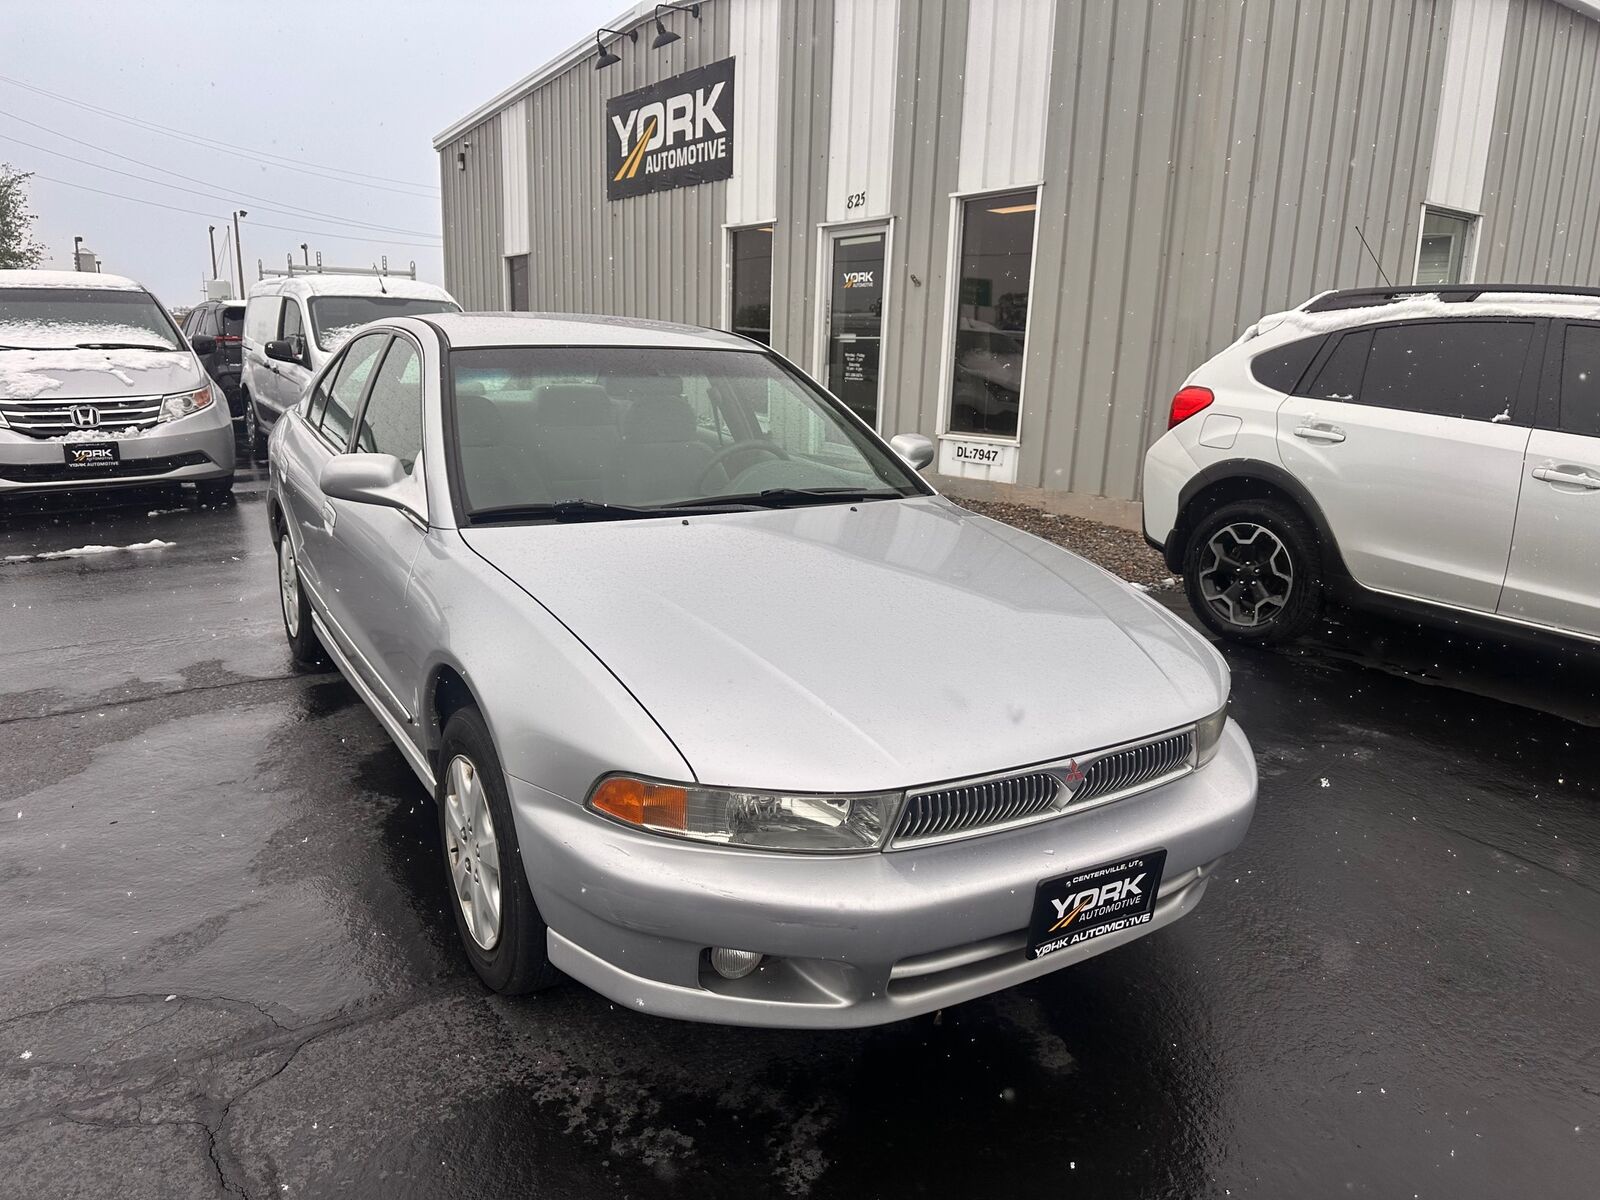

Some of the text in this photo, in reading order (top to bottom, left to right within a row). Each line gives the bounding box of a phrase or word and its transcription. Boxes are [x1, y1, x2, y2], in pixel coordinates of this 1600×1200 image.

[611, 81, 727, 158] YORK
[645, 137, 726, 174] AUTOMOTIVE
[847, 191, 866, 209] 825
[843, 271, 874, 283] YORK
[72, 449, 112, 458] YORK
[956, 446, 999, 462] DL:7947
[1072, 860, 1140, 884] CENTERVILLE, UT
[1051, 873, 1147, 919] YORK
[1078, 895, 1142, 922] AUTOMOTIVE
[1034, 913, 1151, 959] YORK AUTOMOTIVE
